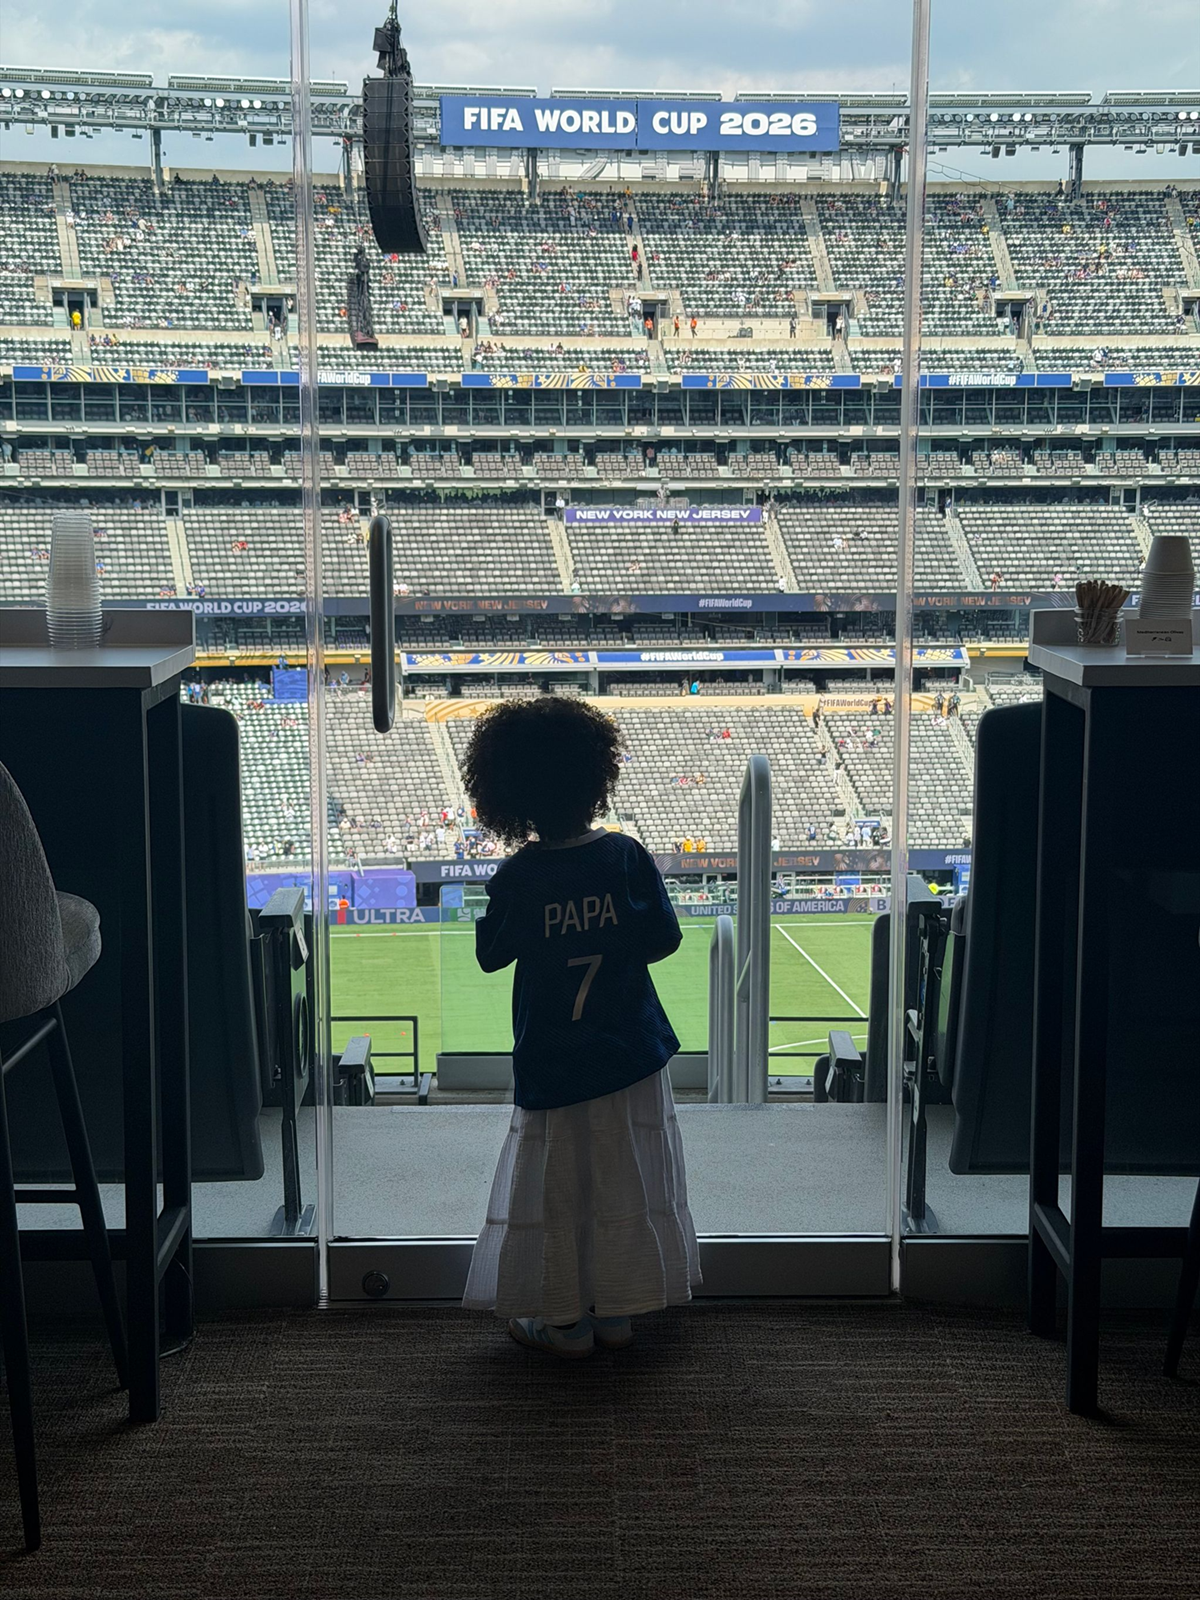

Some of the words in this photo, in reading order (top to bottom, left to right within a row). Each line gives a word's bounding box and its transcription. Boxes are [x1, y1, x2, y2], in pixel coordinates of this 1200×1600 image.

[464, 107, 524, 131] FIFA
[534, 109, 636, 134] WORLD
[652, 111, 708, 135] CUP
[719, 112, 818, 136] 2026
[317, 371, 371, 386] FAWorldCup
[948, 374, 1017, 387] #FIFAWorldCup
[576, 510, 613, 519] NEW
[613, 510, 653, 519] YORK
[656, 510, 692, 519] NEW
[692, 510, 751, 519] JERSEY
[178, 602, 232, 614] WORLD
[237, 602, 263, 613] CUP
[698, 598, 753, 609] #FIFAWorldCup
[640, 651, 724, 661] #FIFAWorldCup
[441, 864, 472, 877] FIFA
[691, 905, 732, 916] UNITED
[775, 902, 792, 912] OF
[792, 900, 844, 912] AMERICA
[353, 908, 425, 924] ULTRA
[544, 893, 618, 938] PAPA
[567, 954, 603, 1021] 7
